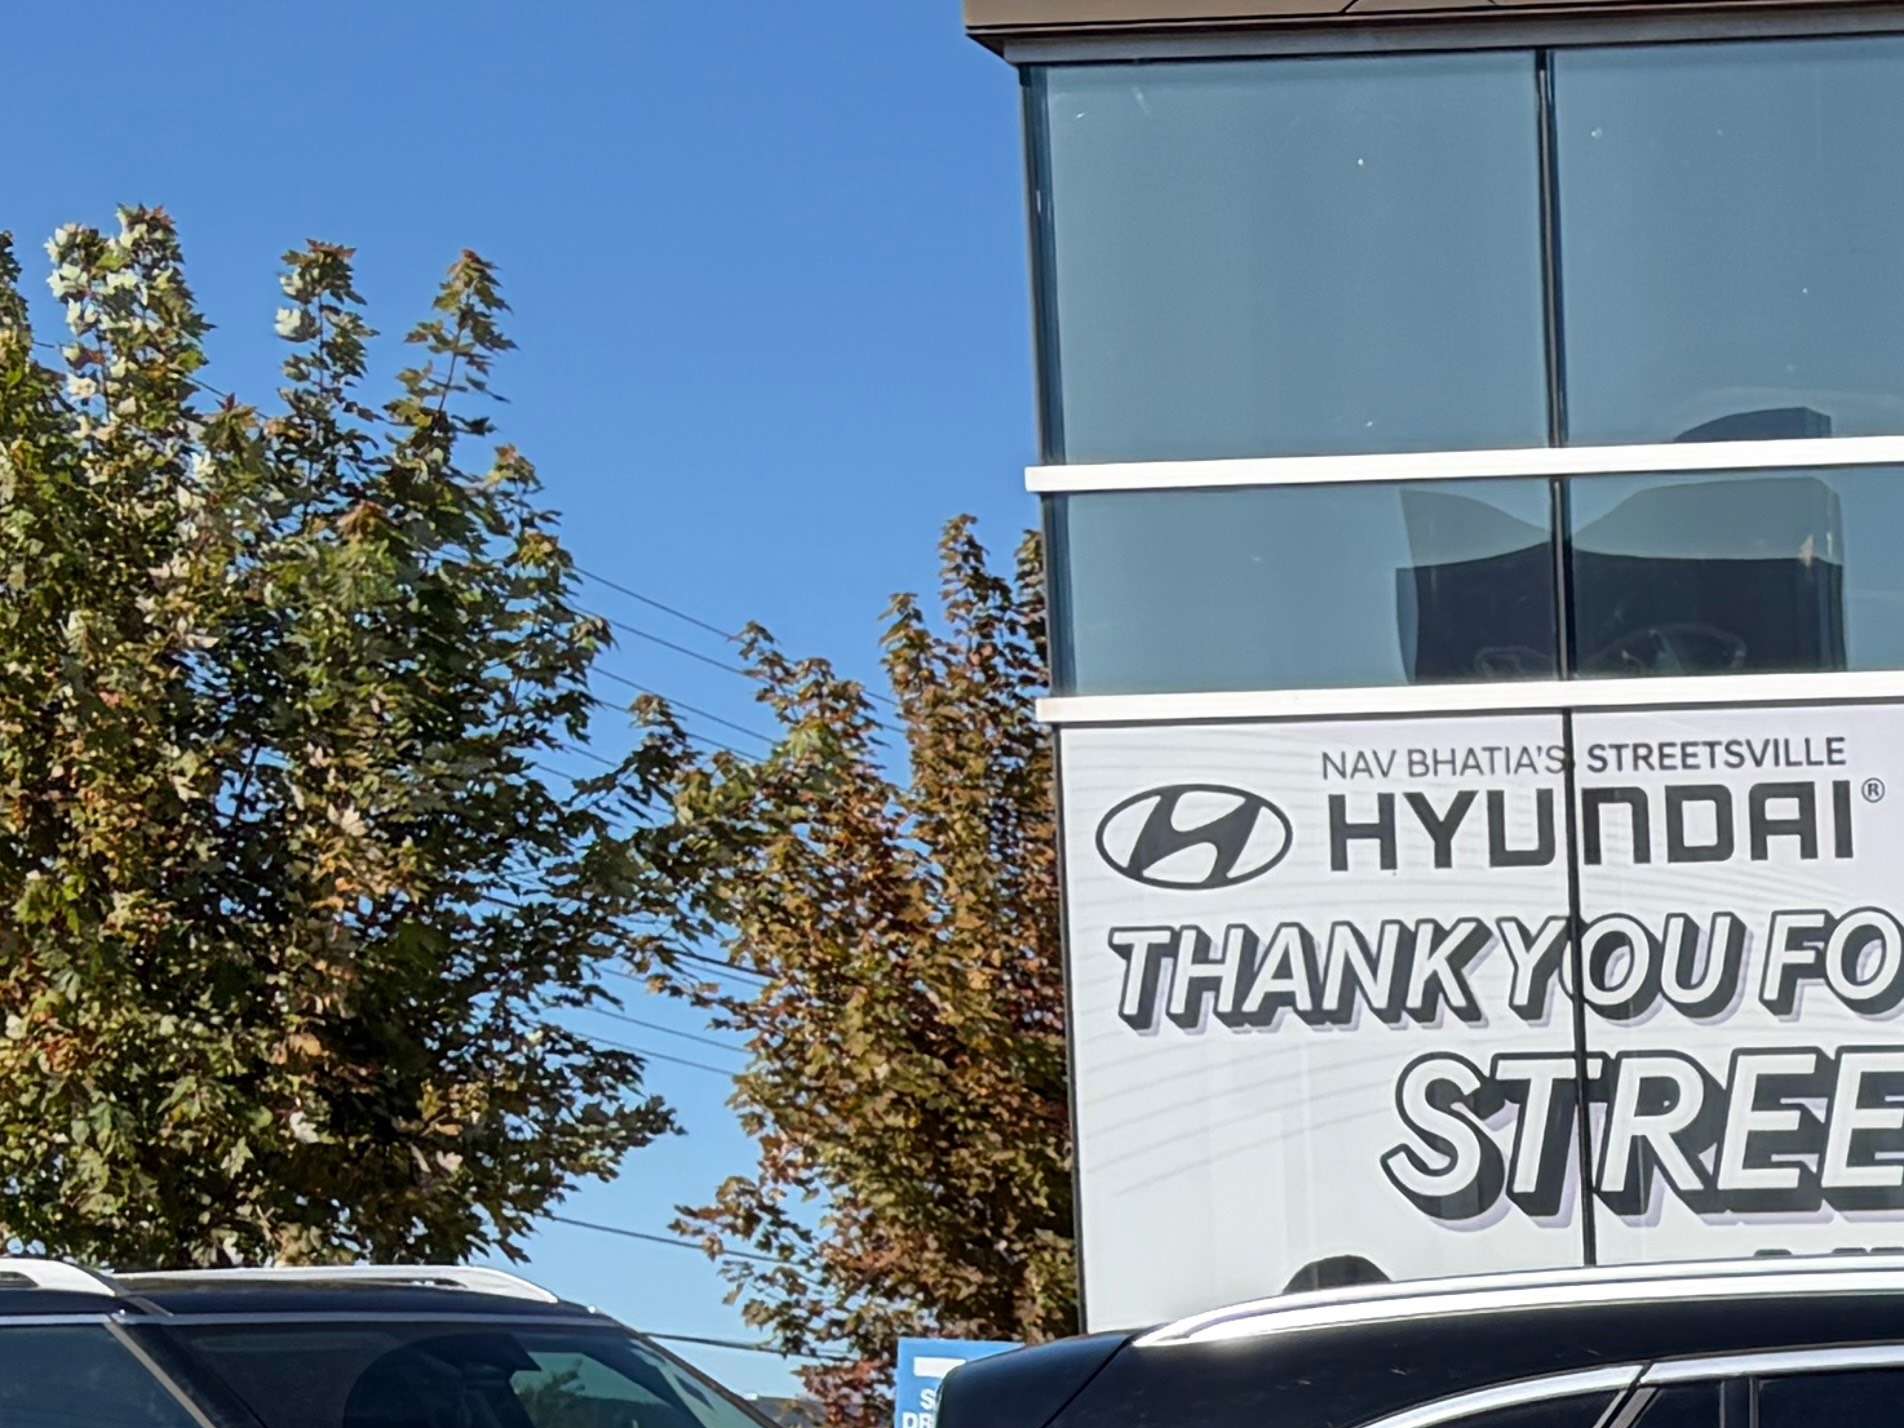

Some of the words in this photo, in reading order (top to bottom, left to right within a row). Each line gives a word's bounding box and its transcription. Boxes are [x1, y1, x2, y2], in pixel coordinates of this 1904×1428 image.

[1321, 749, 1396, 779] NAV
[1406, 745, 1576, 777] BHATIA'S
[1586, 737, 1847, 773] STREETSVILLE
[1108, 917, 1495, 1030] THANK
[1495, 911, 1747, 1024] YOU
